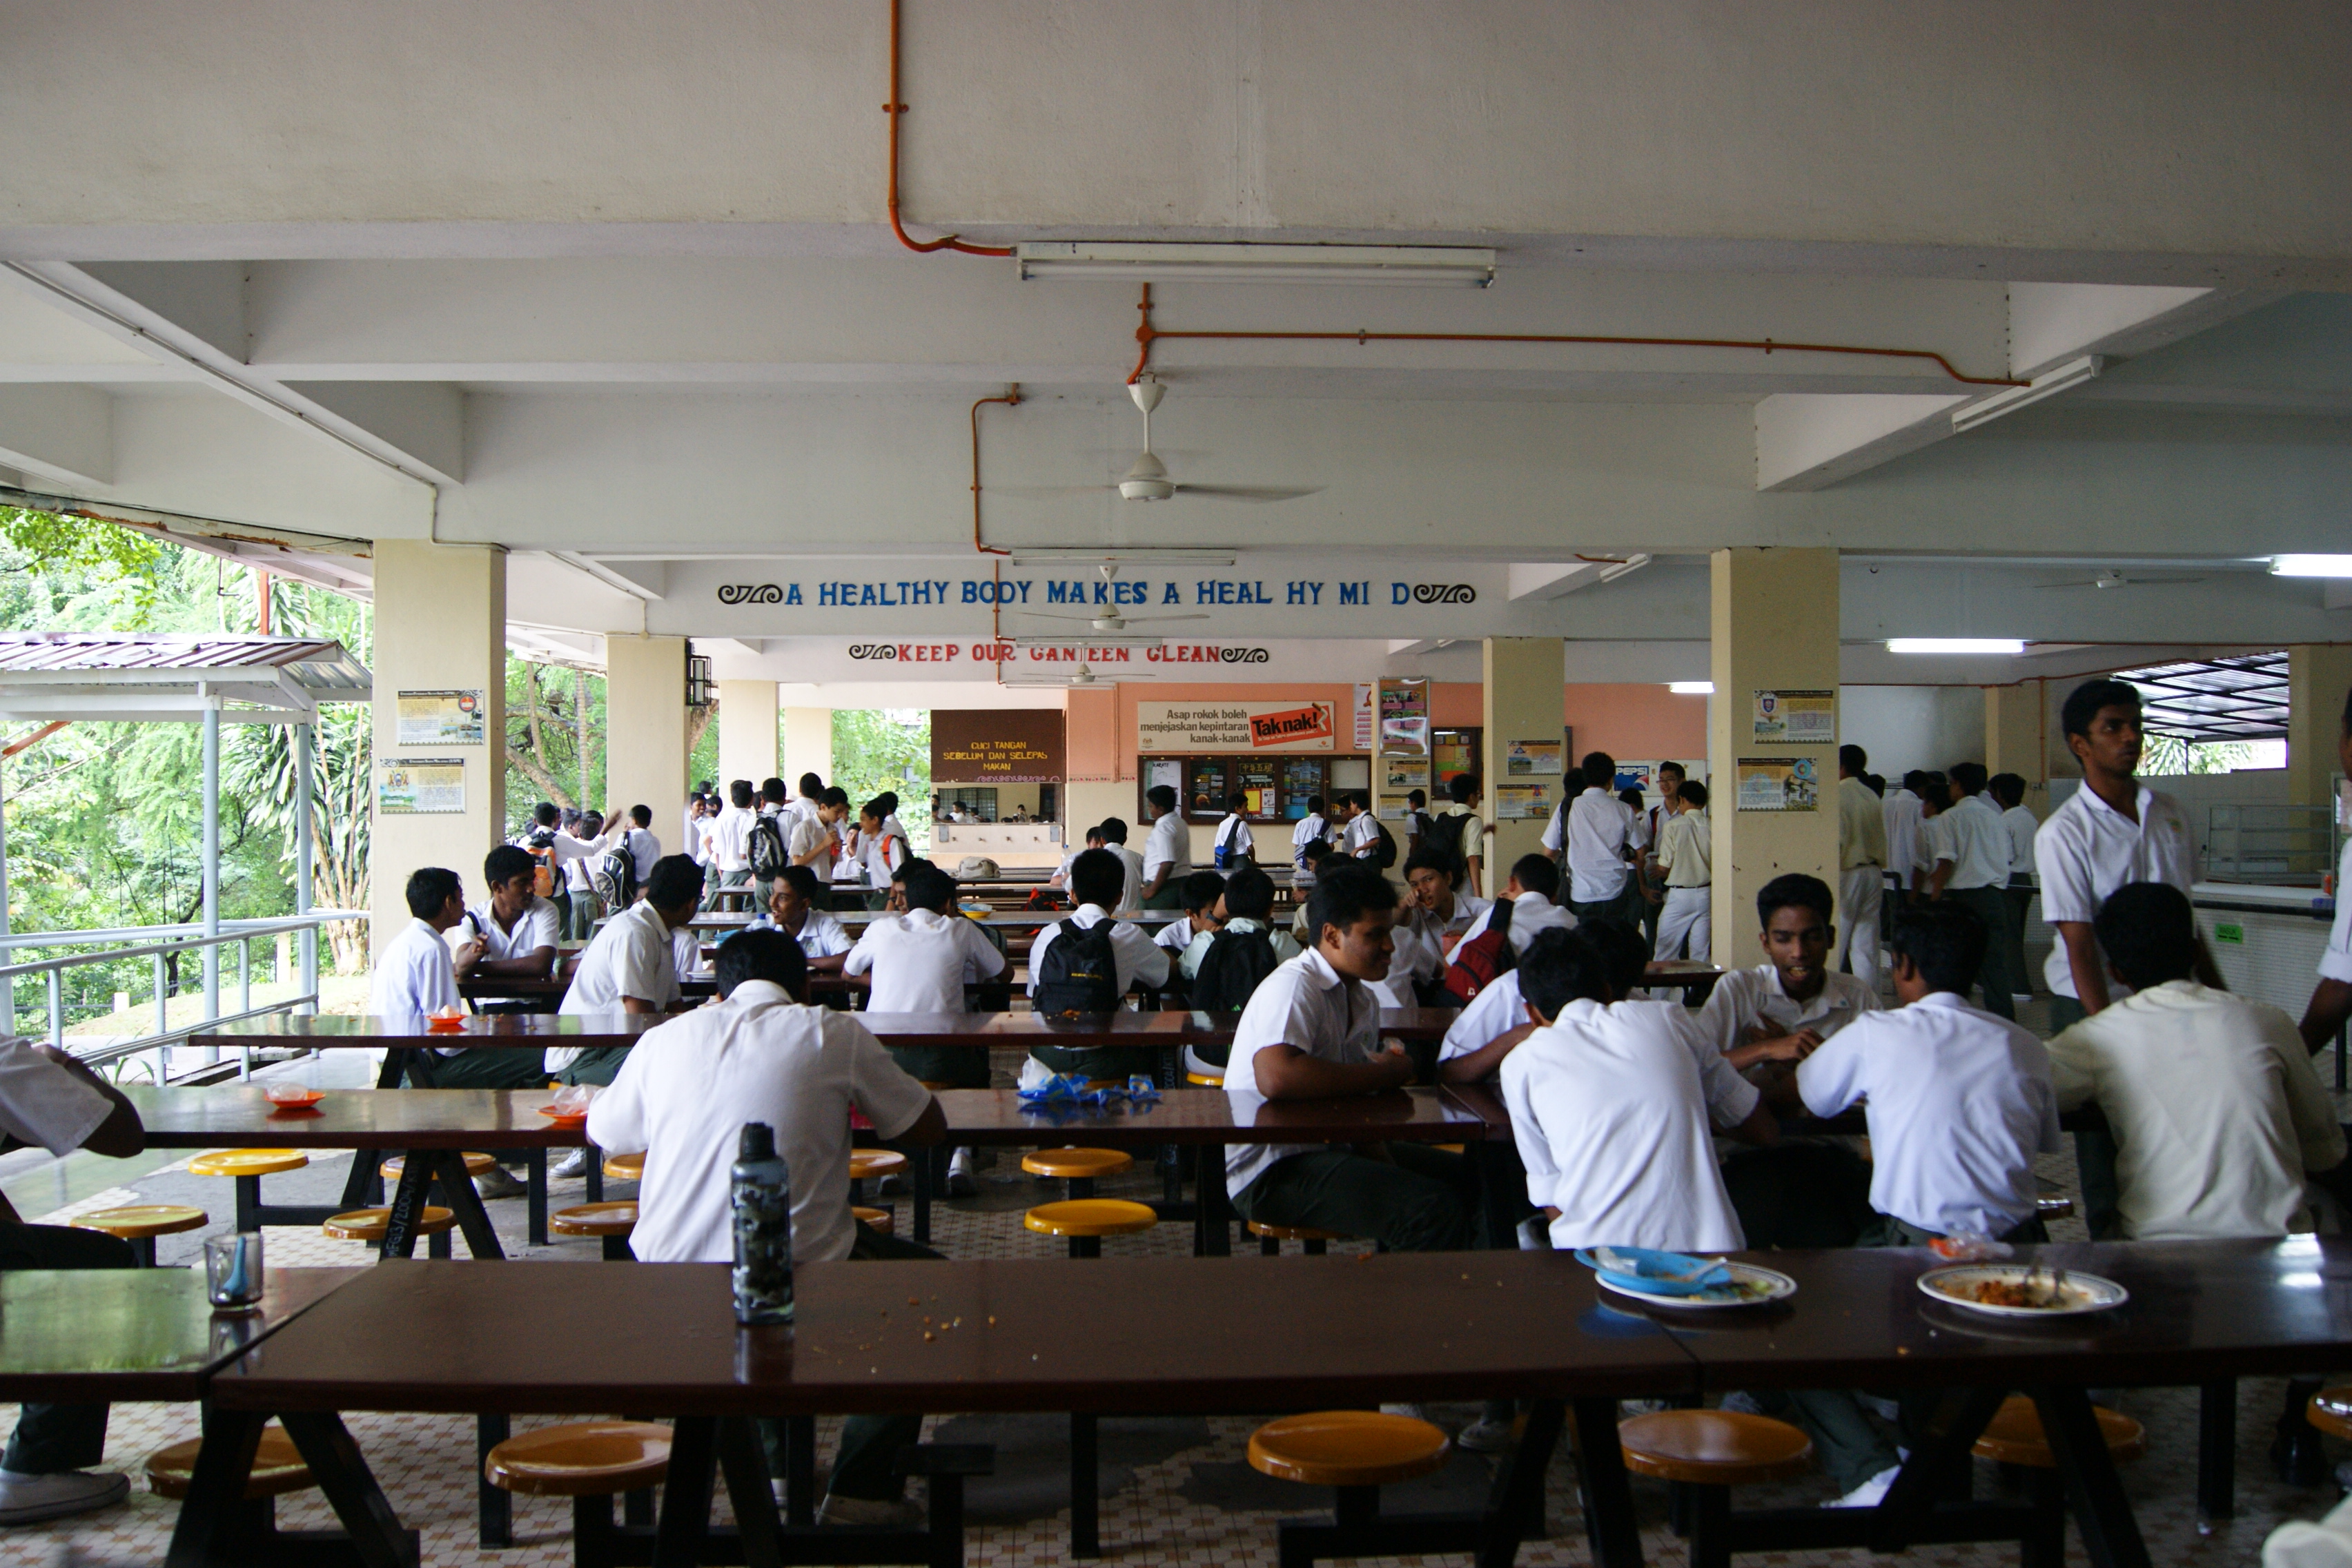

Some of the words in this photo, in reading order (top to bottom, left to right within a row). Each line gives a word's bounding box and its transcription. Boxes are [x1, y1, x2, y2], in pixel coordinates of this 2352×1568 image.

[784, 582, 803, 606] A
[819, 580, 952, 607] HEALTHY
[961, 580, 1032, 604] BODY
[1046, 580, 1148, 605] MAKES
[1162, 582, 1181, 605] A
[898, 644, 959, 662] KEEP
[971, 644, 1017, 662] OUR
[1146, 645, 1220, 663] CLEAN
[1166, 709, 1190, 721] Asap
[1193, 709, 1219, 719] rokok
[1222, 709, 1247, 719] boleh
[1140, 721, 1197, 733] menjejaskan
[1199, 722, 1249, 732] kepintaran
[1252, 718, 1282, 736] Tak
[1282, 712, 1317, 732] nak!
[1190, 734, 1251, 743] kanak-kanak
[994, 741, 1027, 749] TANGAN
[943, 752, 983, 760] SEBELUM
[988, 752, 1006, 760] DAN
[983, 763, 1011, 771] MAKAN
[1616, 767, 1648, 776] PEPSI
